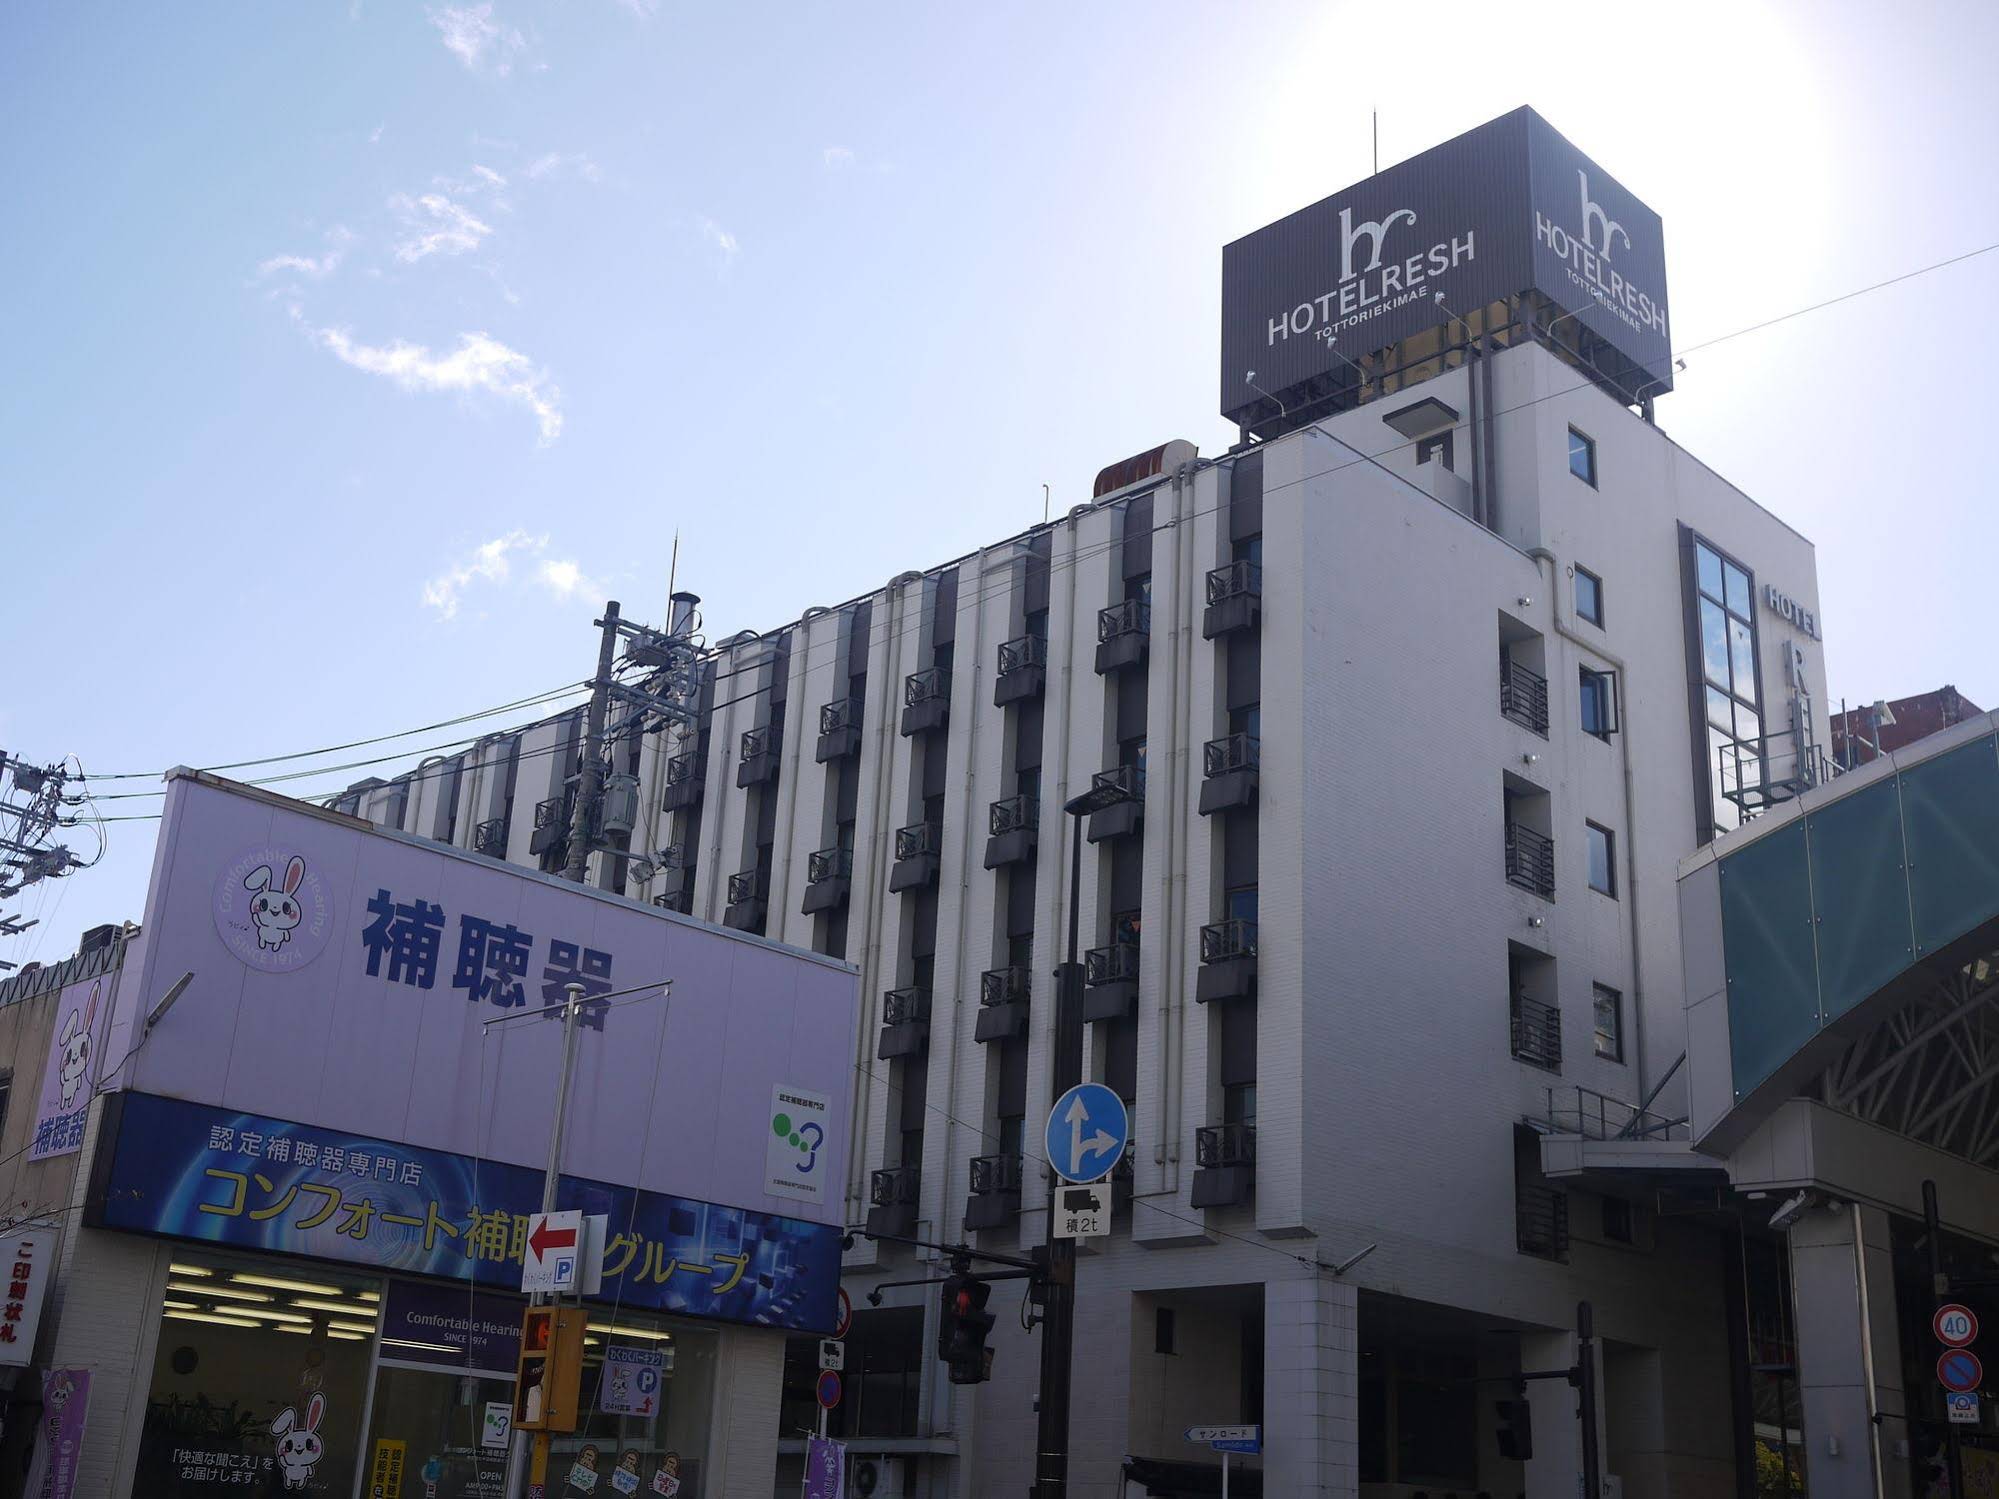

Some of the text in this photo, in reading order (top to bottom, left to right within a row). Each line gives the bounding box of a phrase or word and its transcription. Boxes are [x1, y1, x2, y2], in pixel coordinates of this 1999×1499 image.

[1314, 285, 1427, 341] TOTTORIEKIMAE
[1763, 584, 1821, 641] HOTEL
[362, 888, 613, 1033] 補聴器
[208, 1124, 424, 1187] 認定補聴器専門店
[1066, 1217, 1098, 1233] 積2t
[482, 1320, 523, 1340] Hearin
[1944, 1316, 1968, 1335] 40
[443, 1331, 488, 1346] SINCE 974
[1199, 1429, 1247, 1439] サンロード
[172, 1448, 274, 1470] 「快適な聞こえ」を
[180, 1466, 261, 1485] お届けします。
[480, 1471, 503, 1481] OPEN
